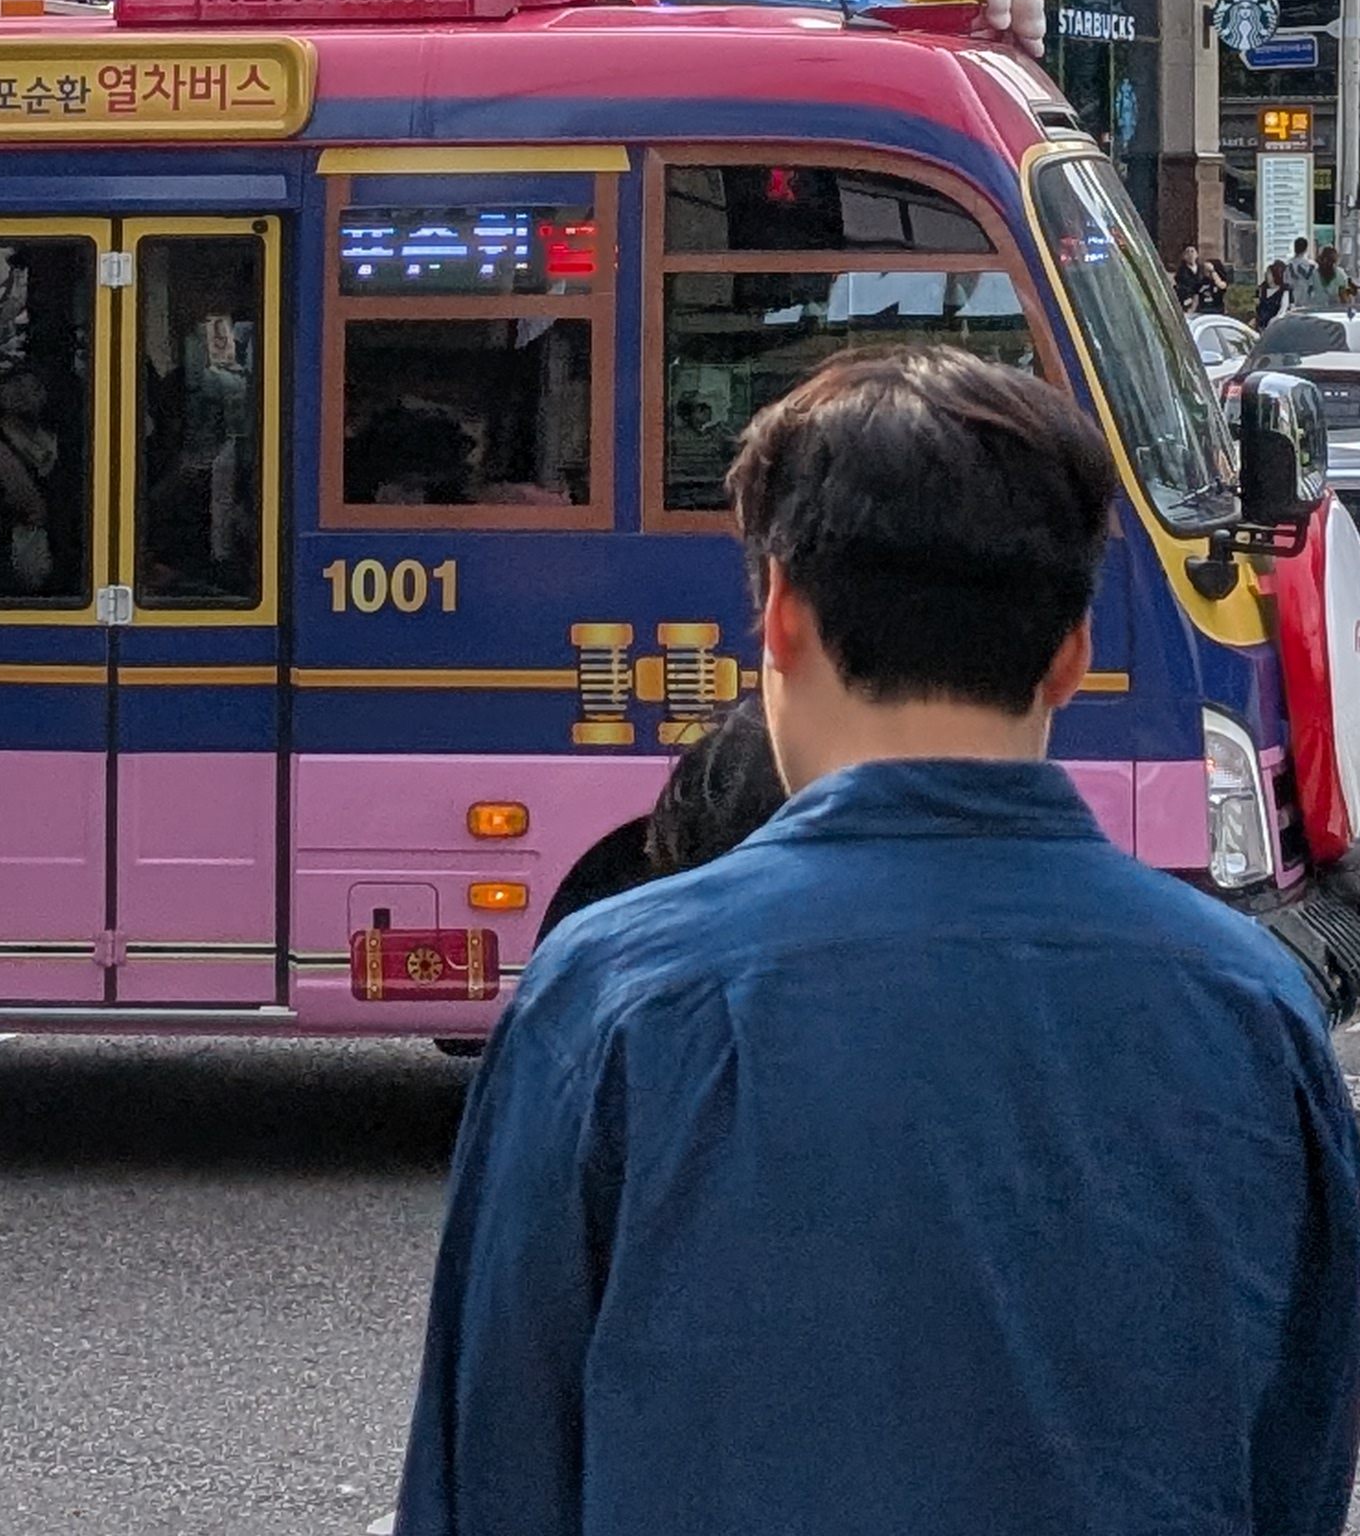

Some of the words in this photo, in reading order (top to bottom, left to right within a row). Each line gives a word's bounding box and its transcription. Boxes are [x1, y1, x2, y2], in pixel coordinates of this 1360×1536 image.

[1058, 9, 1136, 42] STARBUCKS
[97, 64, 276, 113] 열차버스
[322, 558, 457, 613] 1001
